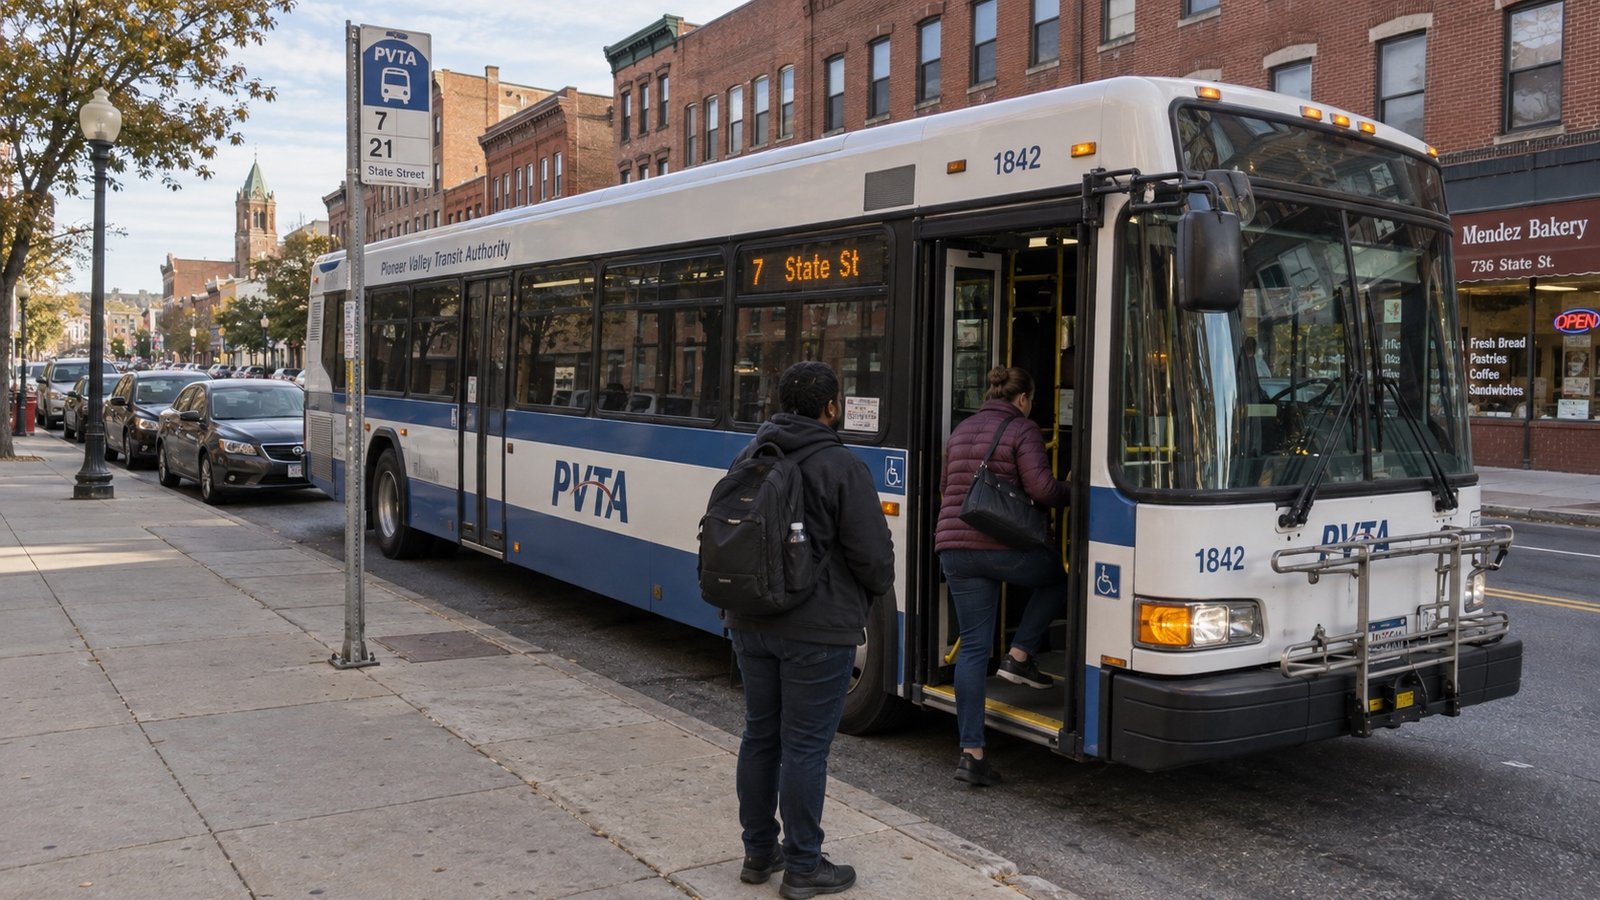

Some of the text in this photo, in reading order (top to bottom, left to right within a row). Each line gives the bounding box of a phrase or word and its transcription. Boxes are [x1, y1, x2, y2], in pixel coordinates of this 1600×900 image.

[374, 46, 417, 66] PVTA
[375, 111, 387, 130] 7
[369, 137, 392, 158] 21
[993, 145, 1041, 174] 1842
[368, 165, 425, 180] State Street
[1462, 216, 1588, 245] Mendez Bakery
[380, 239, 511, 277] Pioneer Valley Transit Authority
[752, 249, 860, 286] 7 State St
[1471, 254, 1555, 273] 736 State St.
[1556, 313, 1597, 330] OPEN
[1470, 337, 1496, 349] Fresh
[1498, 336, 1526, 349] Bread
[1470, 352, 1507, 365] Pastries
[1469, 368, 1500, 380] Coffee
[1469, 383, 1524, 397] Sandwiches
[552, 460, 628, 524] PVTA
[1195, 545, 1245, 574] 1842
